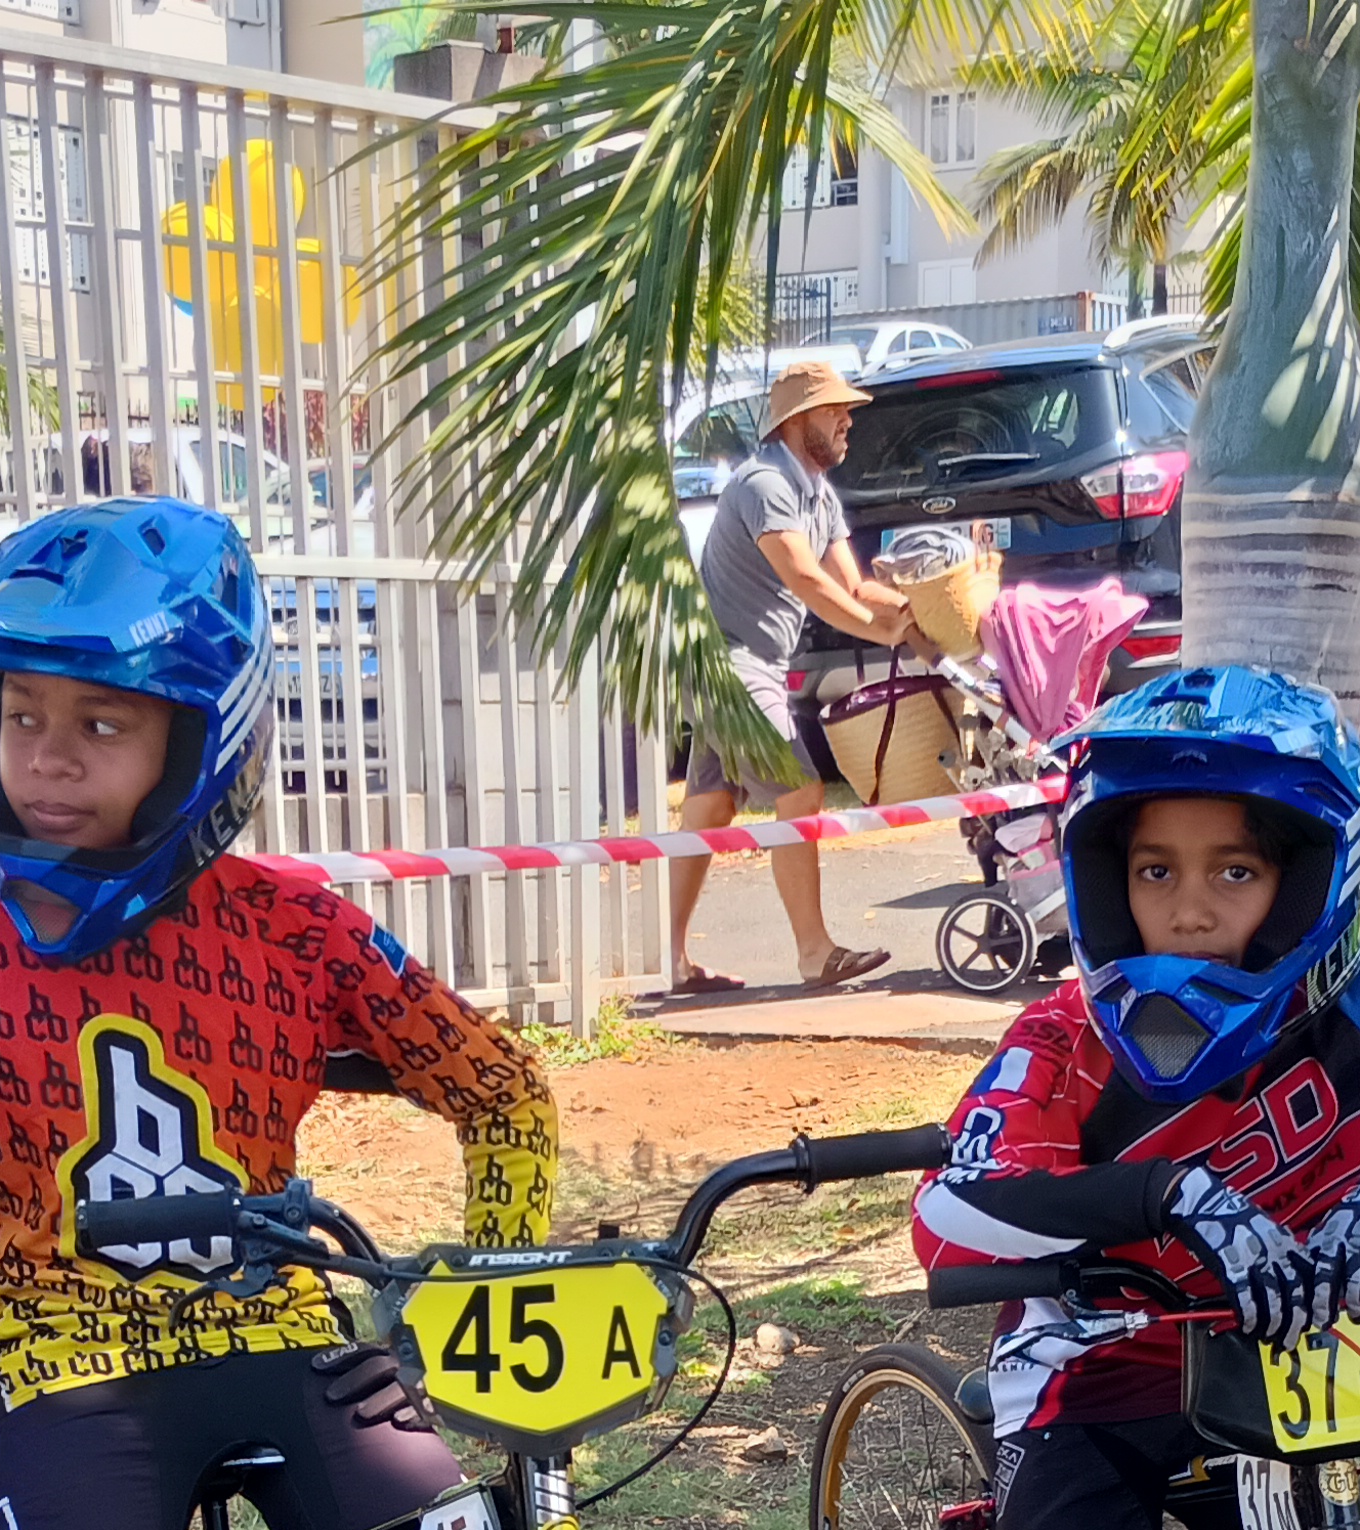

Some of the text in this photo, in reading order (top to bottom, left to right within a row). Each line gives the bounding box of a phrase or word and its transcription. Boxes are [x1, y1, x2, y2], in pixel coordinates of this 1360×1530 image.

[128, 611, 170, 648] KENNY
[468, 1250, 573, 1268] INSIGHT
[441, 1283, 642, 1394] 45 A
[1268, 1332, 1340, 1440] 37
